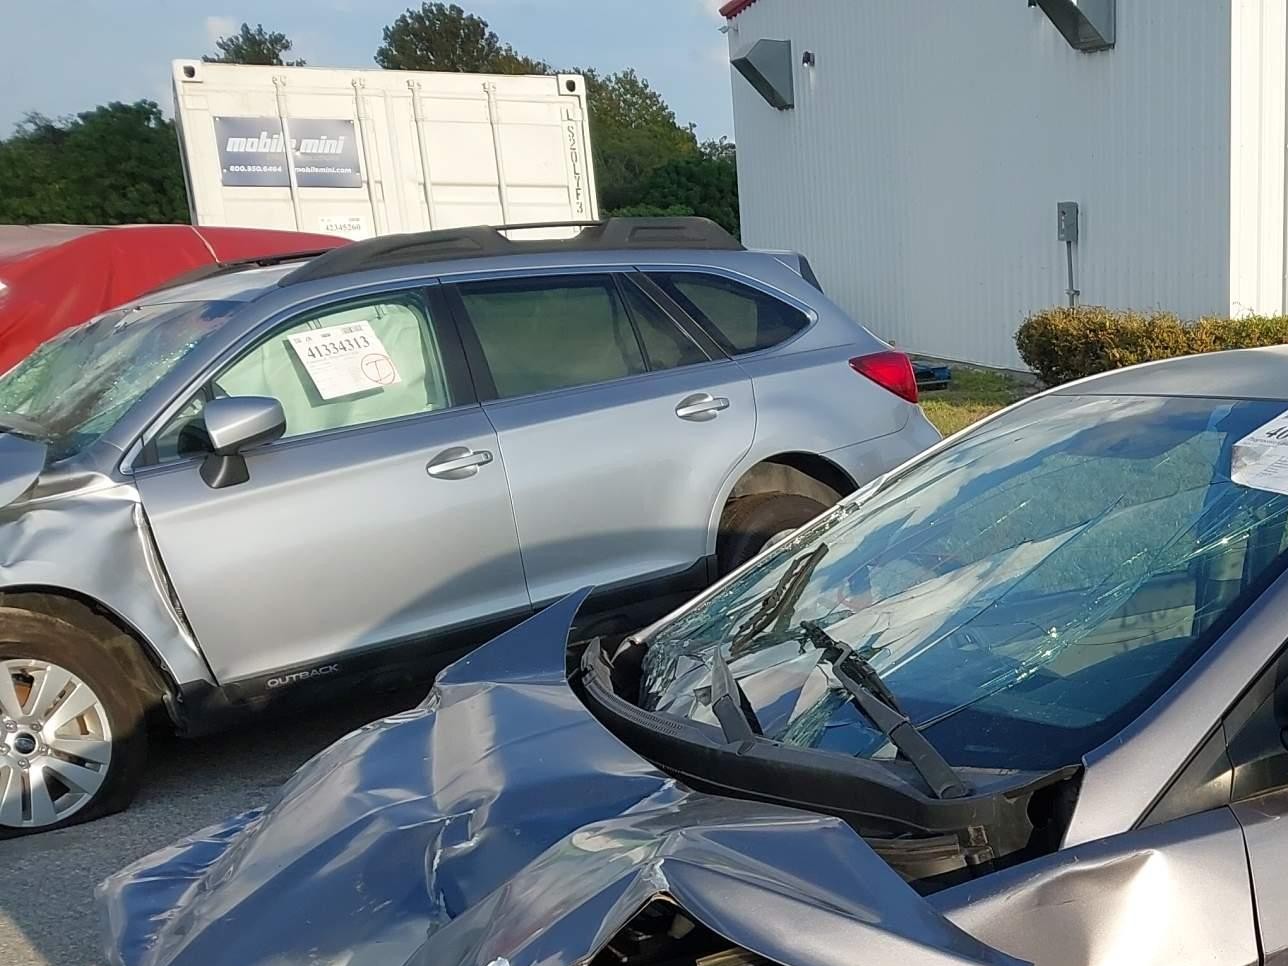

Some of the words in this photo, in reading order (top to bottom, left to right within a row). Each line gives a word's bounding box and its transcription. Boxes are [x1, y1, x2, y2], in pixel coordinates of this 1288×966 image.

[300, 136, 345, 154] mini
[307, 335, 370, 359] 41334313
[267, 664, 339, 688] OUTBACK
